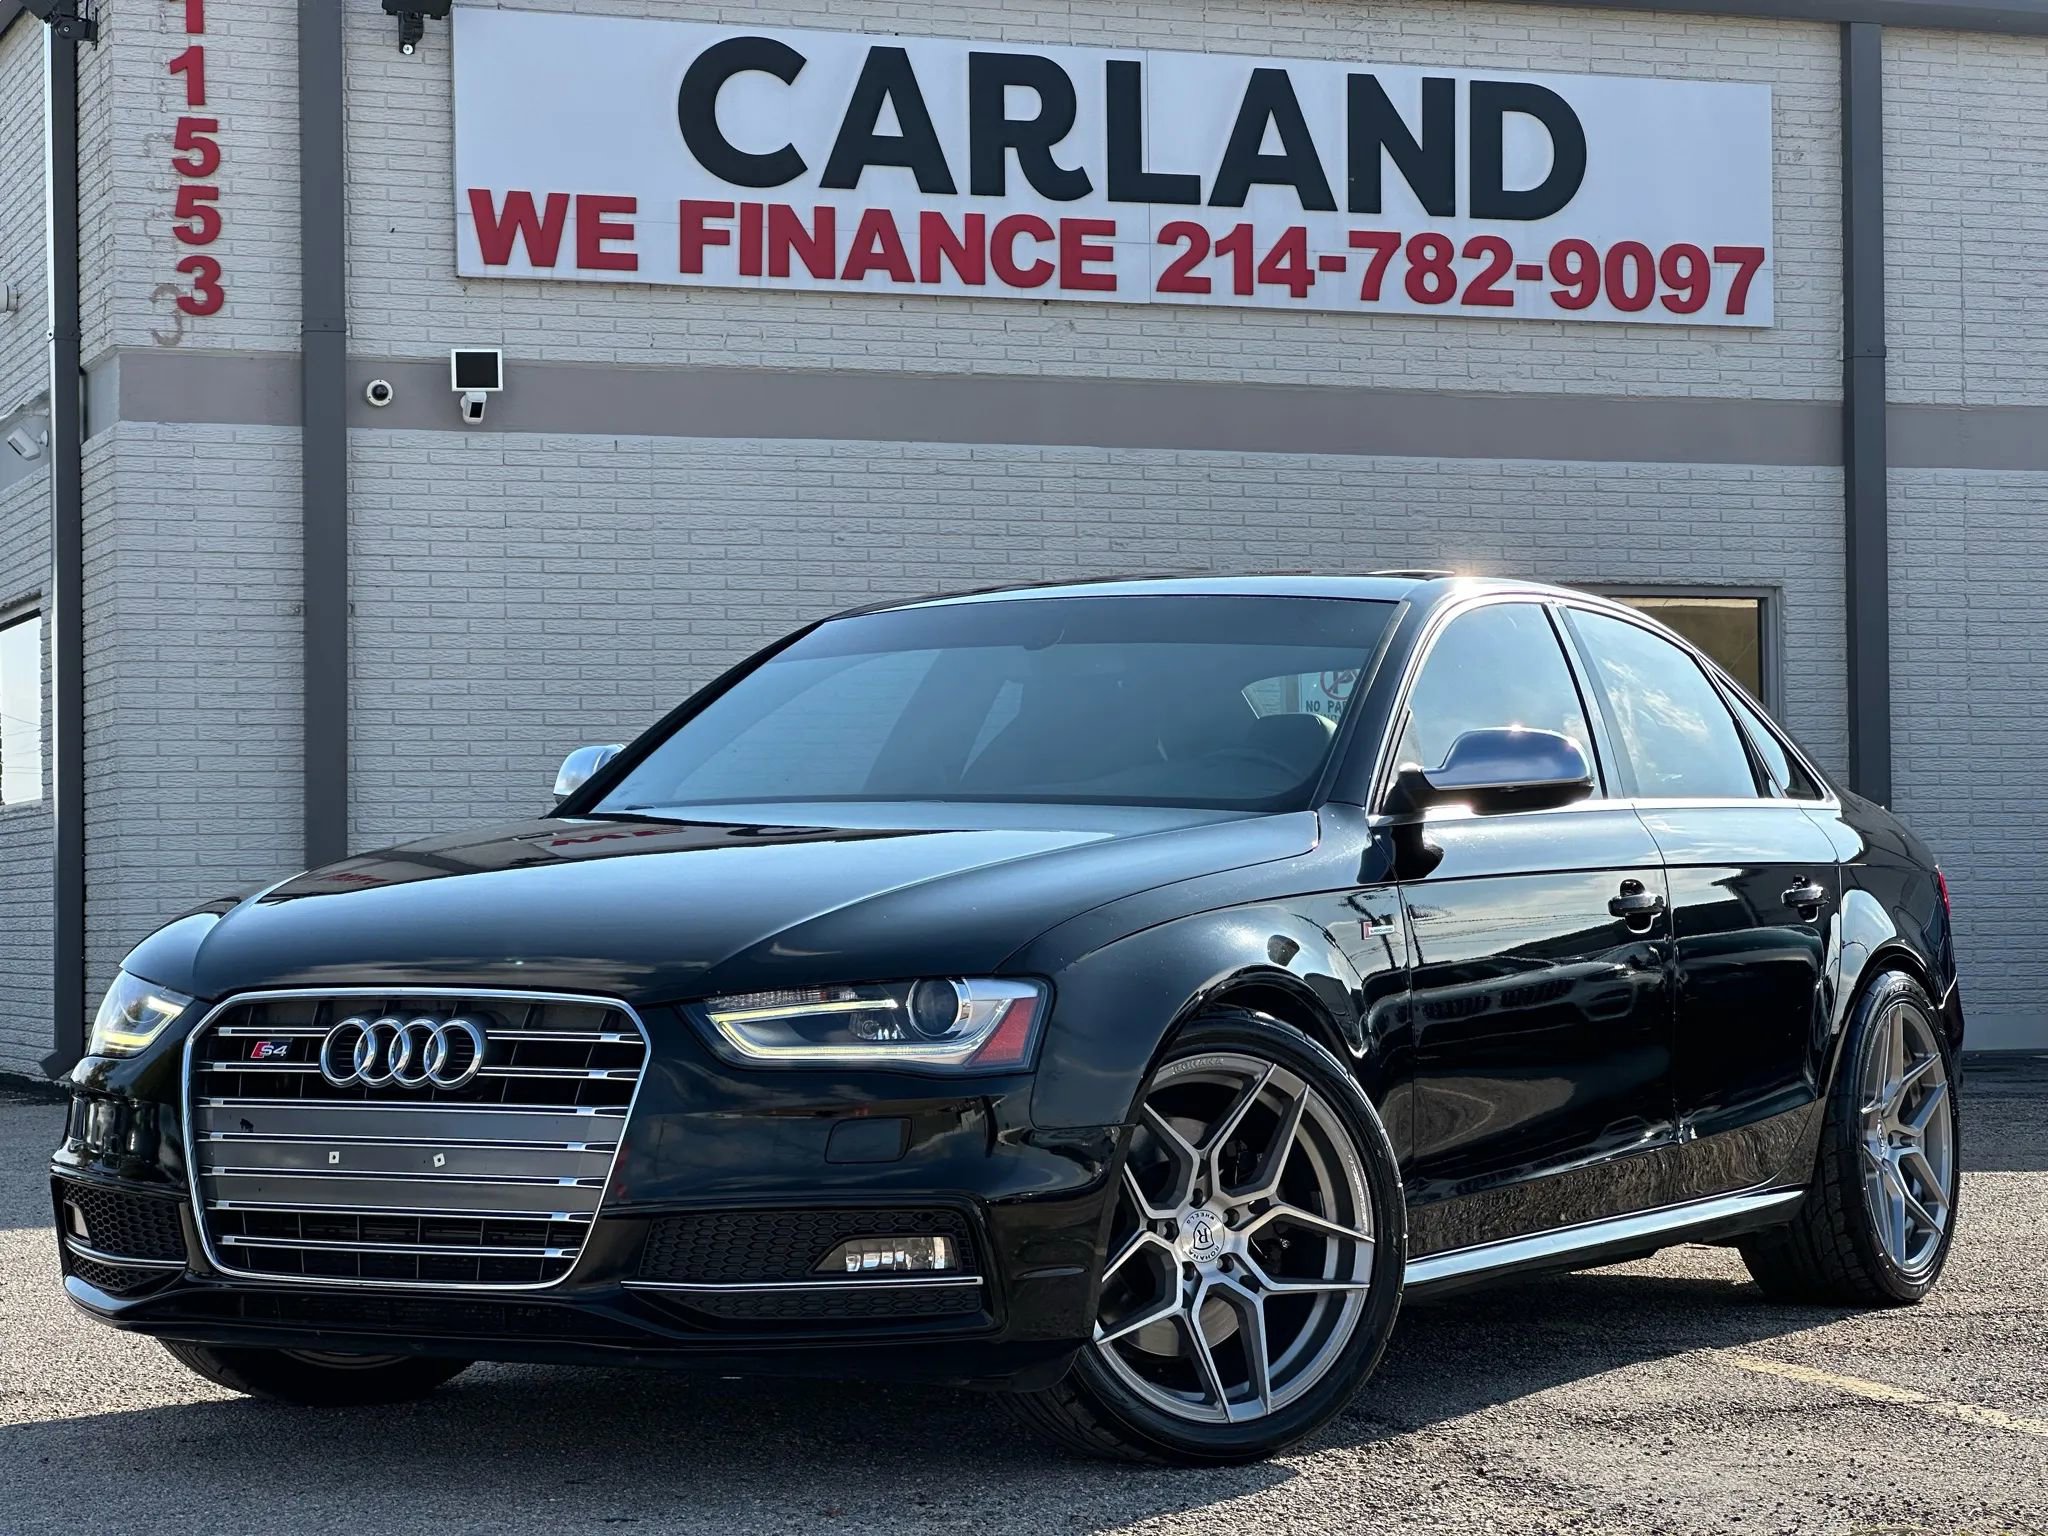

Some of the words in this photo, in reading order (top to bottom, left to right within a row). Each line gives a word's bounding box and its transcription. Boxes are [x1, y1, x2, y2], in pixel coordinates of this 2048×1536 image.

[677, 36, 1588, 222] CARLAND
[469, 189, 638, 271] WE
[680, 201, 1116, 292] FINANCE
[1158, 222, 1766, 315] 214-782-9097
[1305, 700, 1321, 713] NO
[260, 1044, 288, 1057] S4
[1197, 1228, 1209, 1244] R
